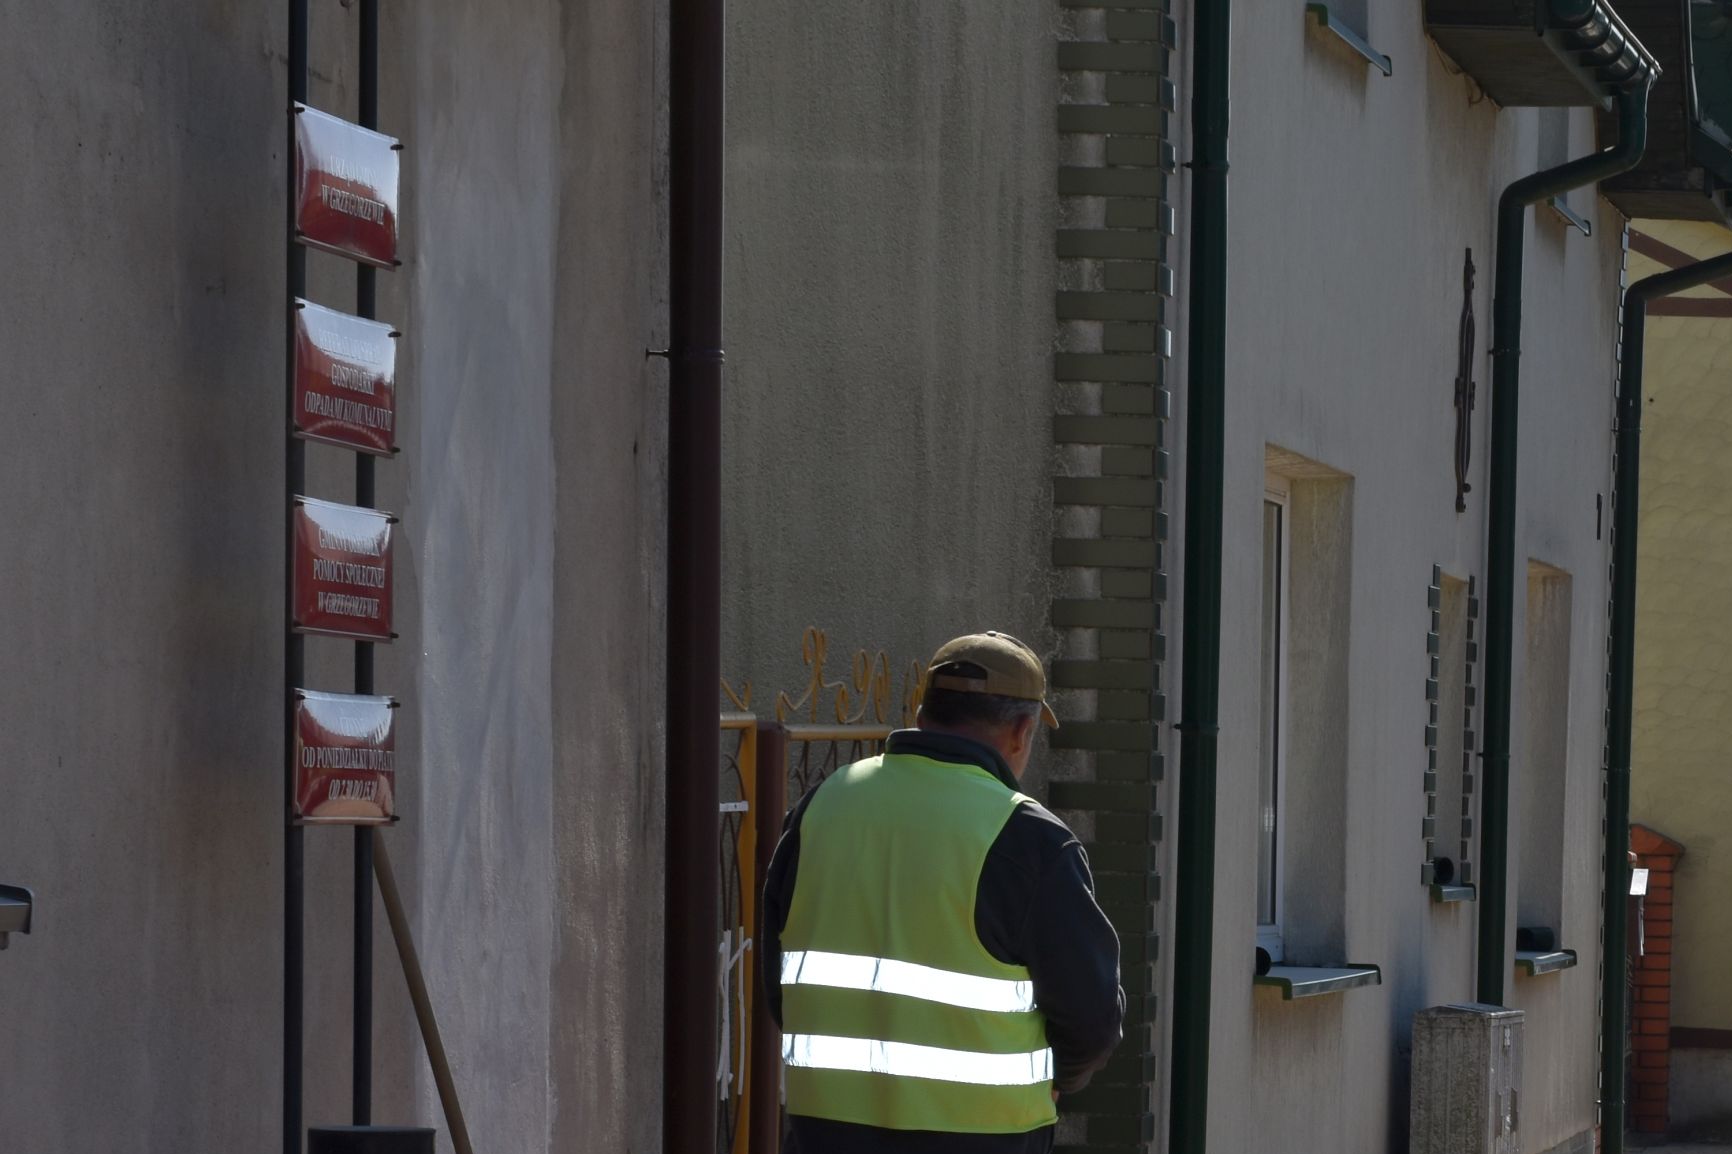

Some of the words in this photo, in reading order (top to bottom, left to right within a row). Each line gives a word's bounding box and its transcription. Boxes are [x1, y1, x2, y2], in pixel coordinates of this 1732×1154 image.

[321, 184, 329, 209] W
[329, 187, 385, 226] GRZEGORZEWIE
[304, 390, 343, 421] ODPADAMI
[312, 558, 345, 583] POMOCY
[317, 591, 324, 613] W
[325, 592, 380, 620] GRZEGORZEWIE
[302, 746, 316, 769] OD
[328, 779, 340, 801] OD
